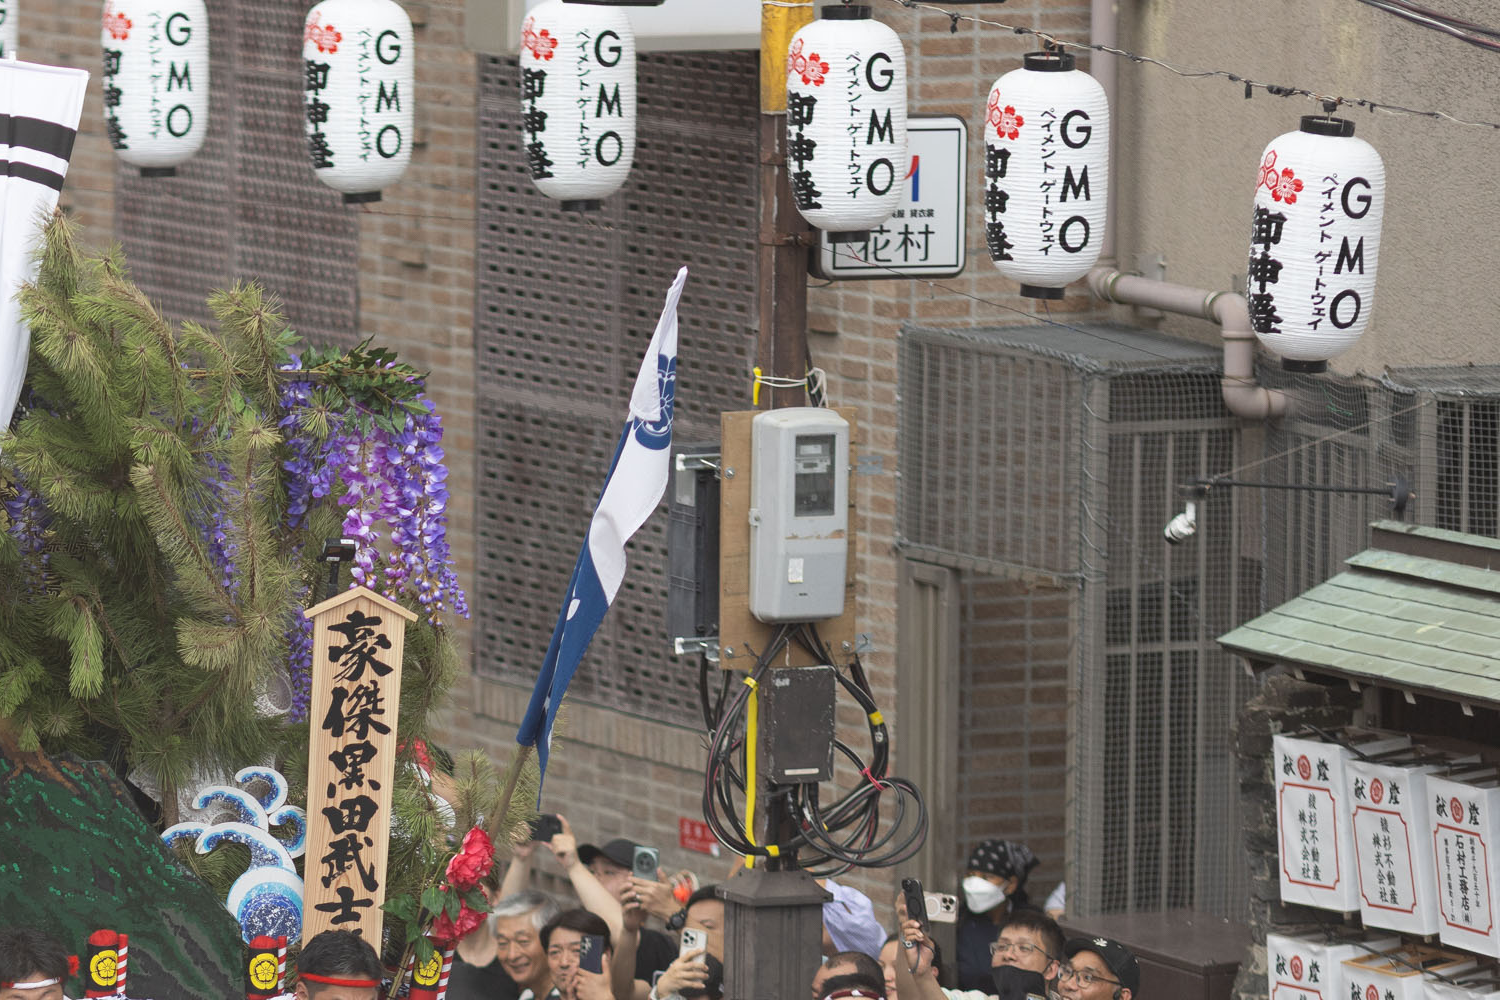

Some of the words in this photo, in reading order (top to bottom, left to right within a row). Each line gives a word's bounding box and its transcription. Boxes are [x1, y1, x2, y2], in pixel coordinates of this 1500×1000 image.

[166, 12, 193, 137] GMO
[376, 29, 401, 158] GMO
[594, 30, 623, 167] GMO
[865, 52, 895, 196] GMO
[856, 223, 936, 263] 花村
[1058, 109, 1093, 254] GMO
[1329, 176, 1373, 330] GMO
[314, 609, 394, 934] 豪傑黒田武士
[1298, 808, 1312, 881] 株式会社
[1372, 832, 1389, 903] 株式会社
